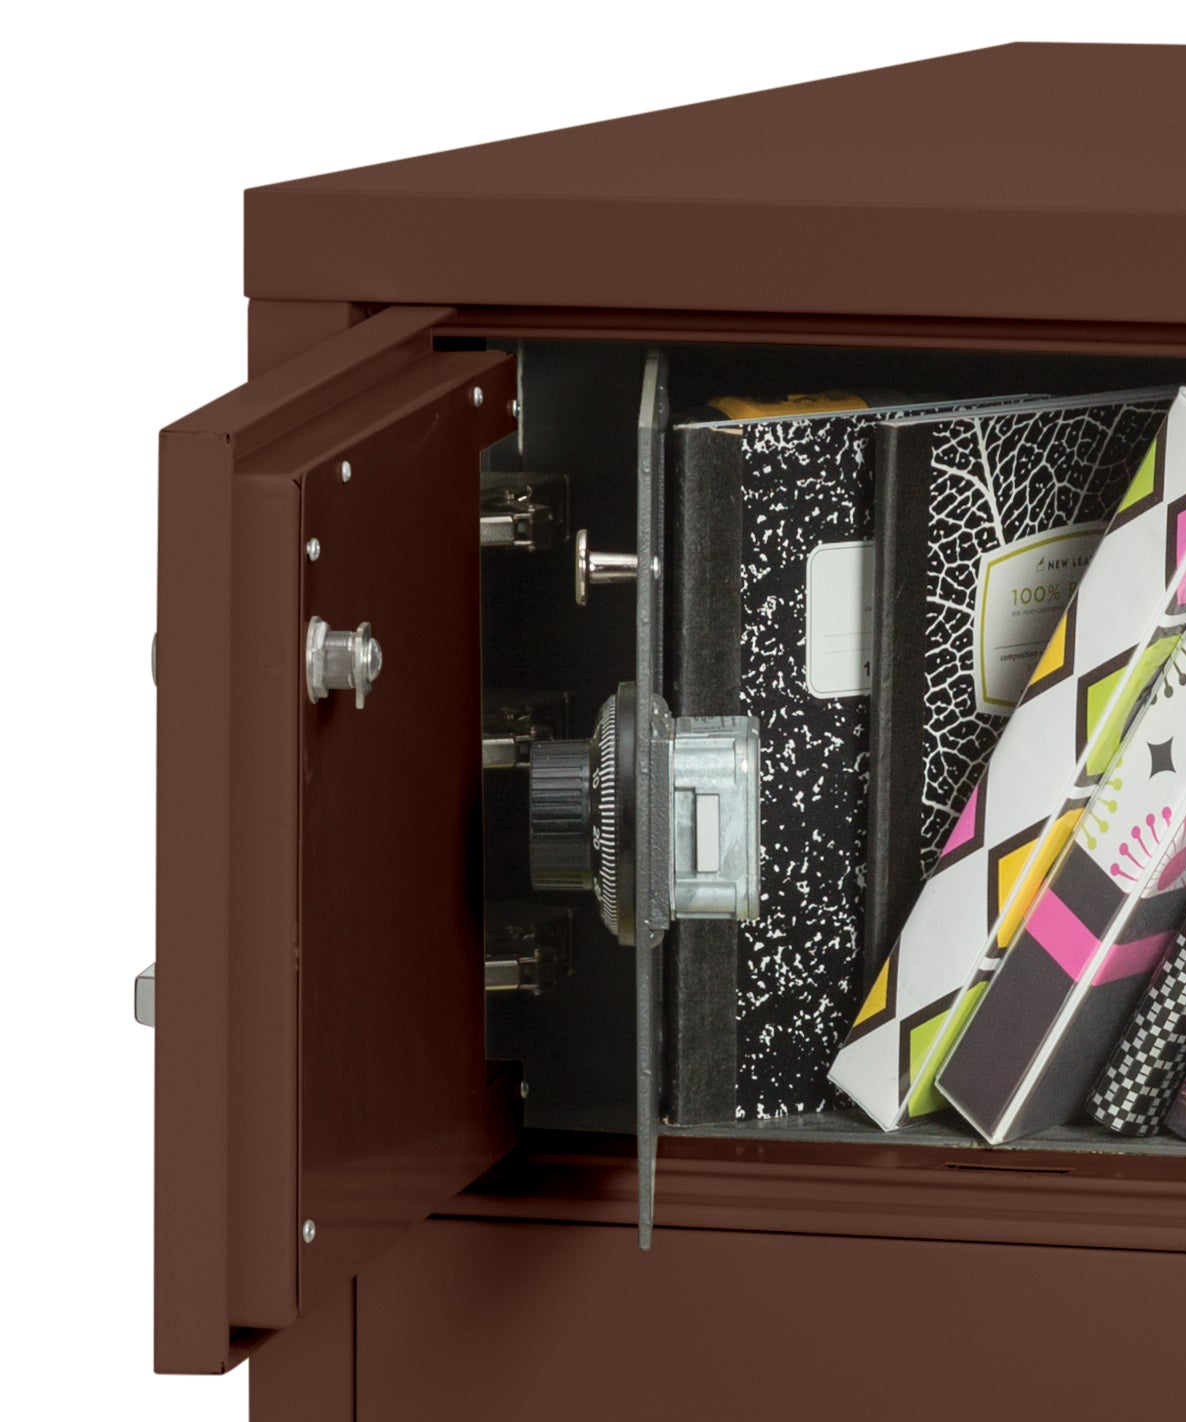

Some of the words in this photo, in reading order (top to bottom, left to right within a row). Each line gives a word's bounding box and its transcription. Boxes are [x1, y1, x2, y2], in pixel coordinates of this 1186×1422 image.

[1048, 558, 1069, 570] NEW
[1072, 556, 1093, 568] LEA
[1012, 583, 1061, 606] 100%
[592, 767, 600, 789] 10
[592, 825, 601, 850] 20
